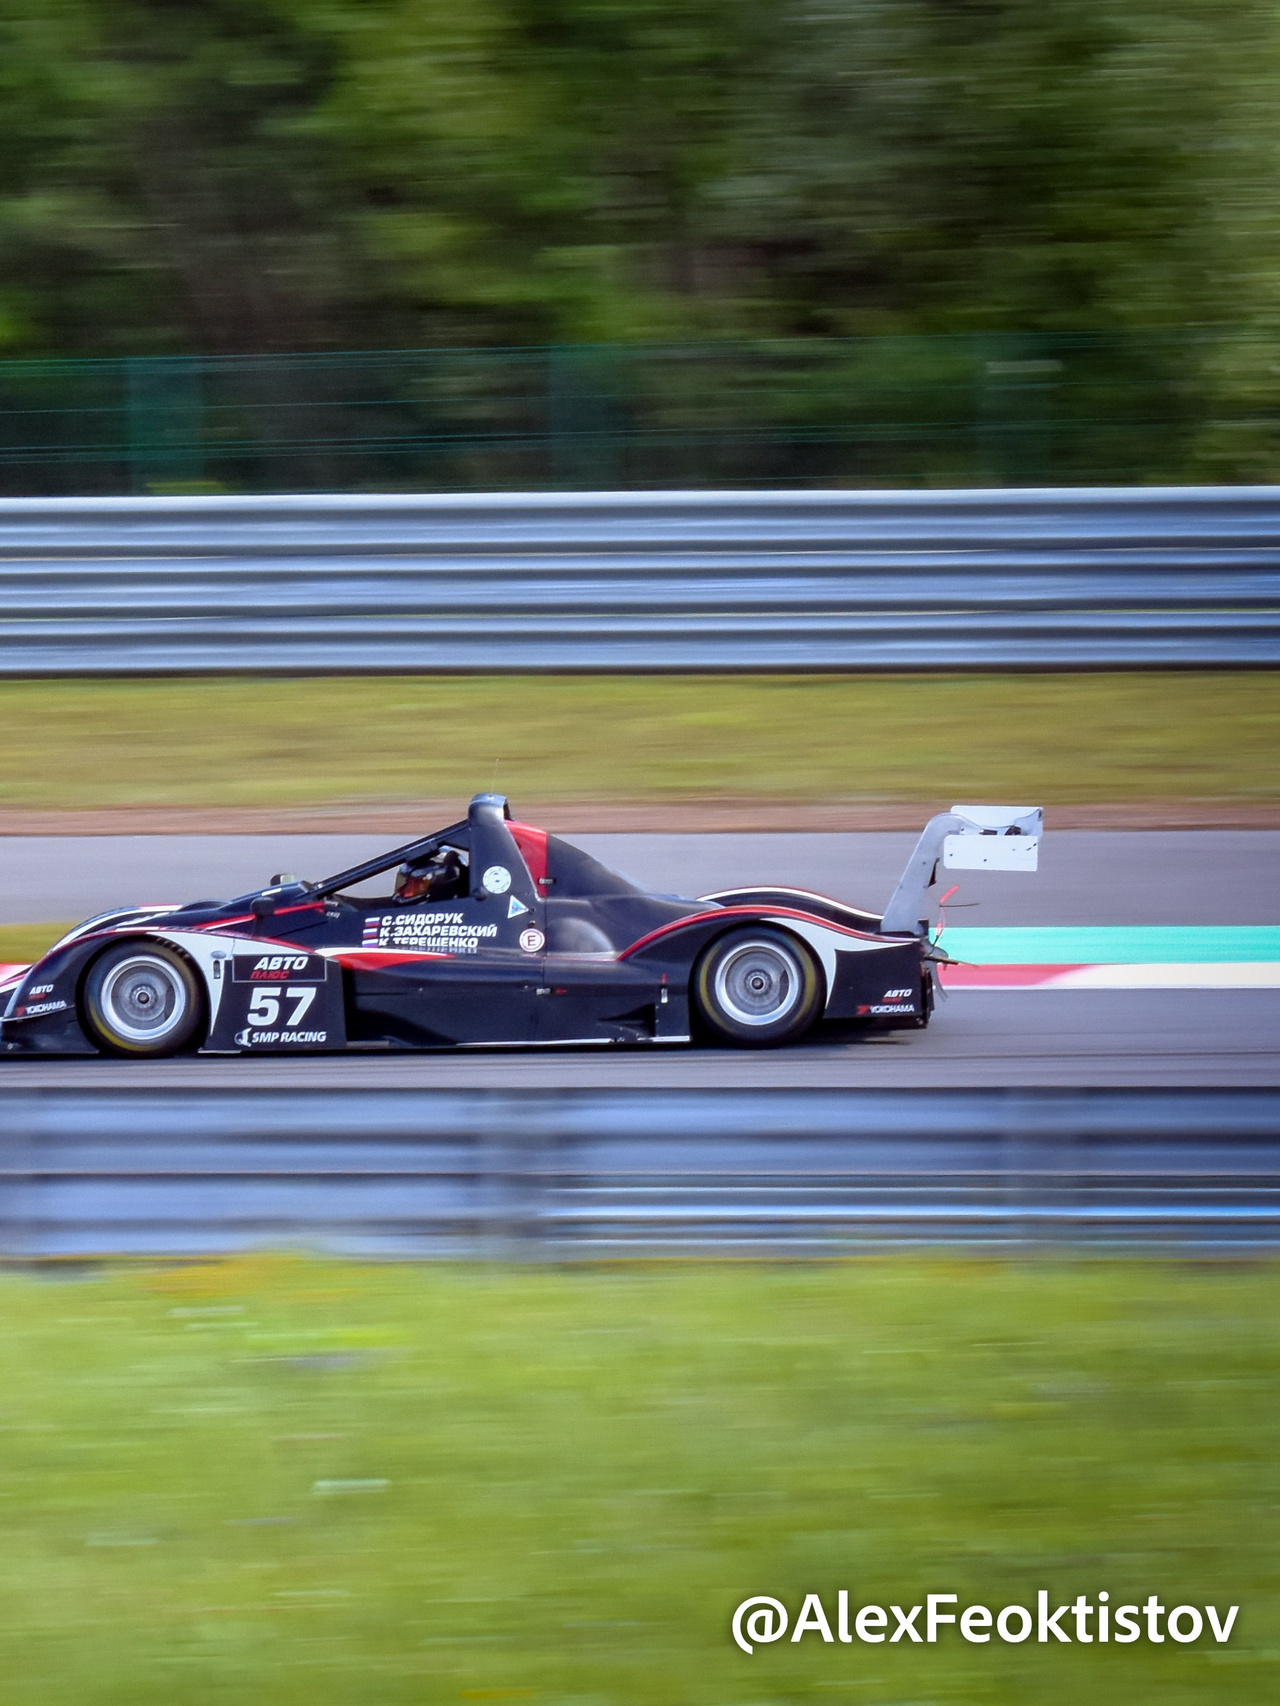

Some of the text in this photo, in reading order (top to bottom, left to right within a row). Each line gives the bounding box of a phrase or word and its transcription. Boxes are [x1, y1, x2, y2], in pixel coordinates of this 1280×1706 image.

[381, 912, 464, 927] С.СИДОРУК
[379, 923, 498, 937] К.ЗАХАРЕВСКИЙ
[253, 956, 309, 971] АВТО
[247, 986, 317, 1027] 57
[251, 1031, 327, 1043] SMP RACING
